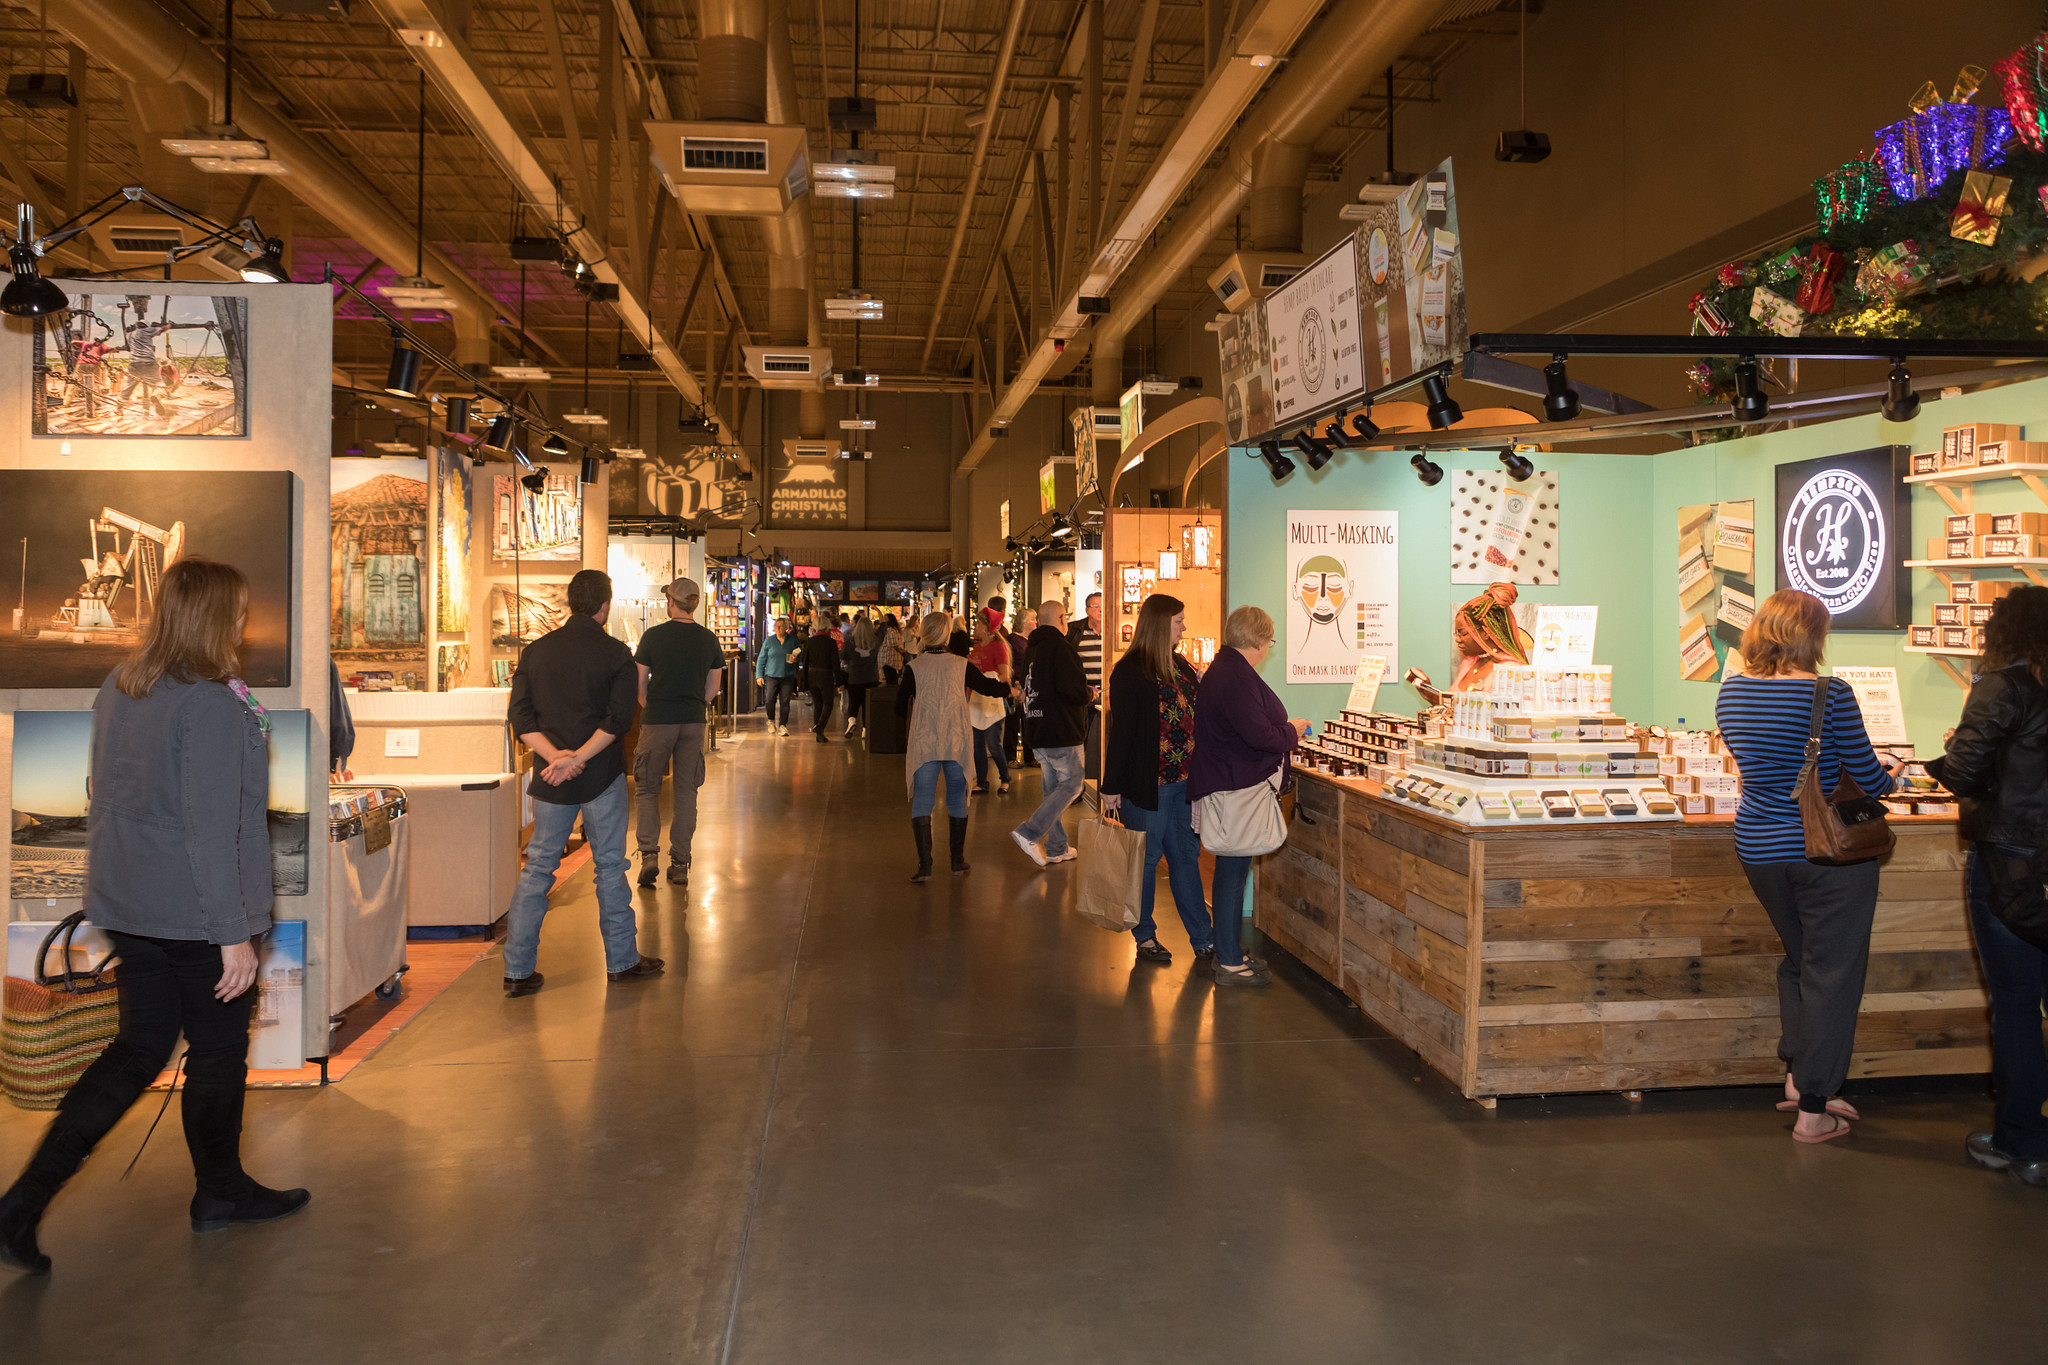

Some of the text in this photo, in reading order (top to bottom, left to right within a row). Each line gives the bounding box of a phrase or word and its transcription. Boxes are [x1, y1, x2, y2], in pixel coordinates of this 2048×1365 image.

[772, 488, 846, 499] ARMADILLO
[1801, 476, 1862, 506] HEMP360
[772, 501, 846, 511] CHRISTMAS
[1292, 522, 1393, 544] MULTI-MASKING
[1816, 567, 1849, 579] Est.2008
[1293, 664, 1306, 675] ONE
[1309, 666, 1328, 675] MASK
[1331, 666, 1337, 675] IS
[1340, 666, 1359, 675] NEVE
